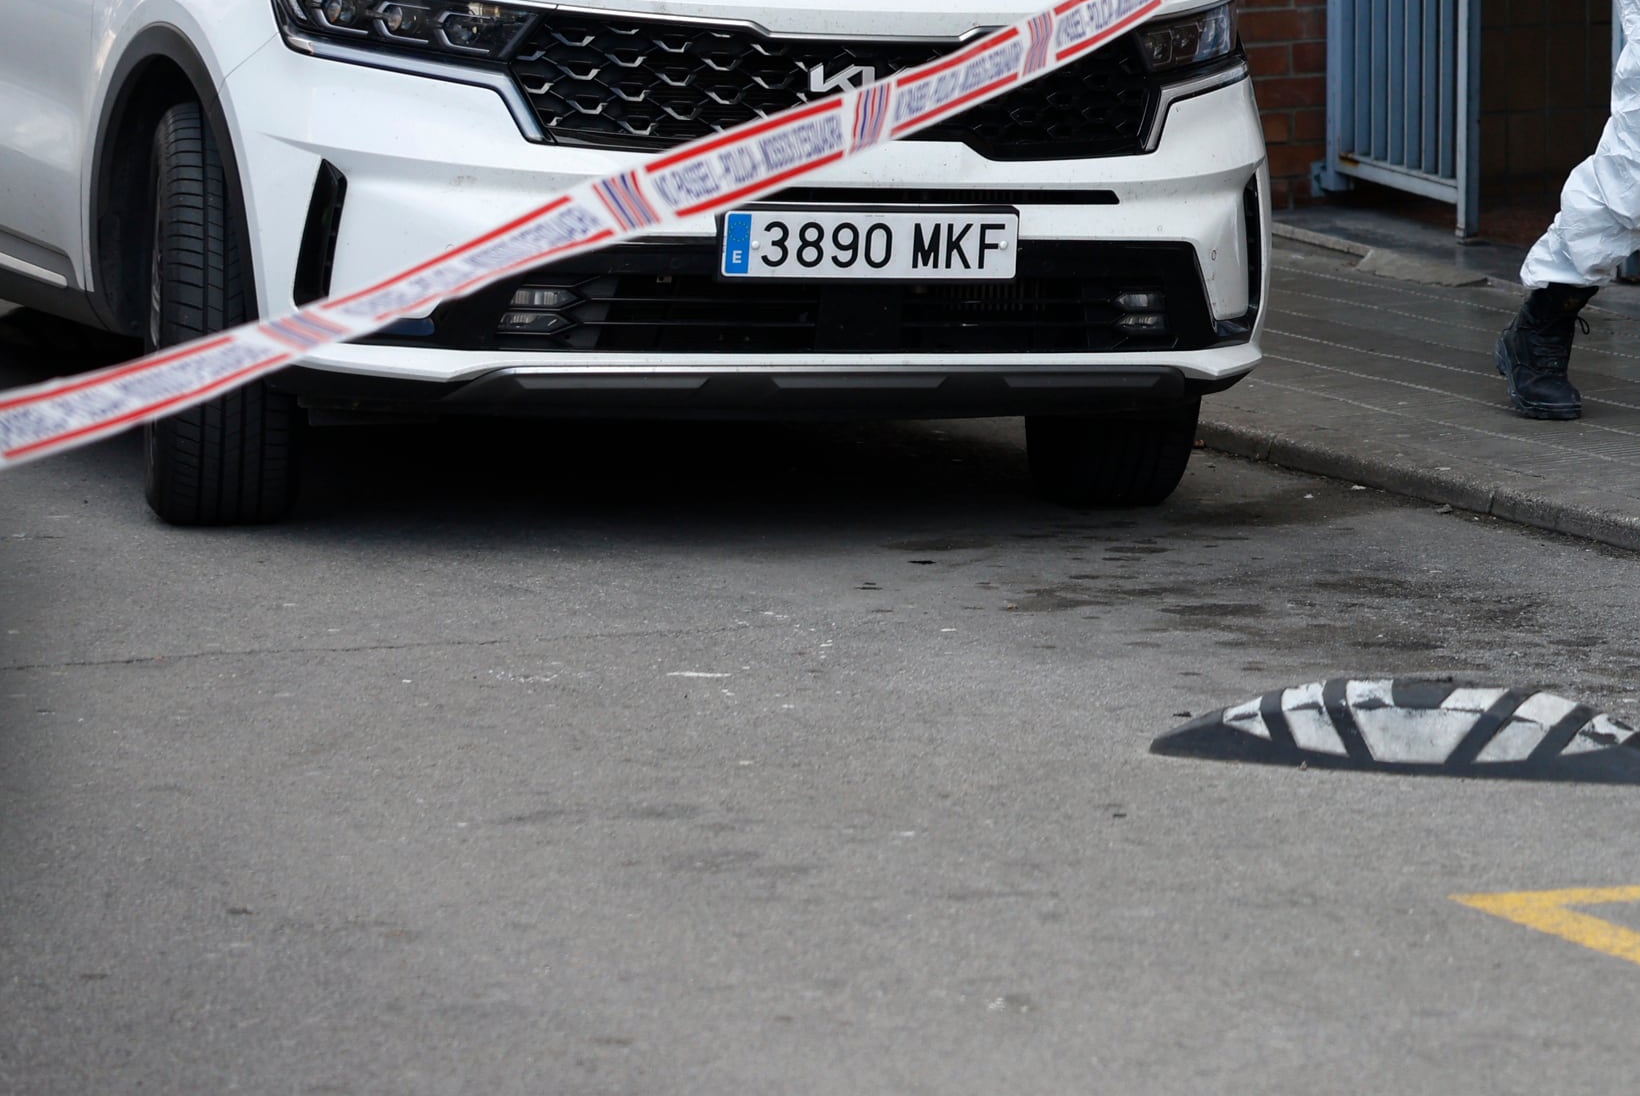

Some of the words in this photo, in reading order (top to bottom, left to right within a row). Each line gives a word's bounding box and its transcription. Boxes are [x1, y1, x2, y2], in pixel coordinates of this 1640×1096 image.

[732, 250, 743, 264] E
[761, 221, 892, 268] 3890
[911, 223, 1006, 270] MKF
